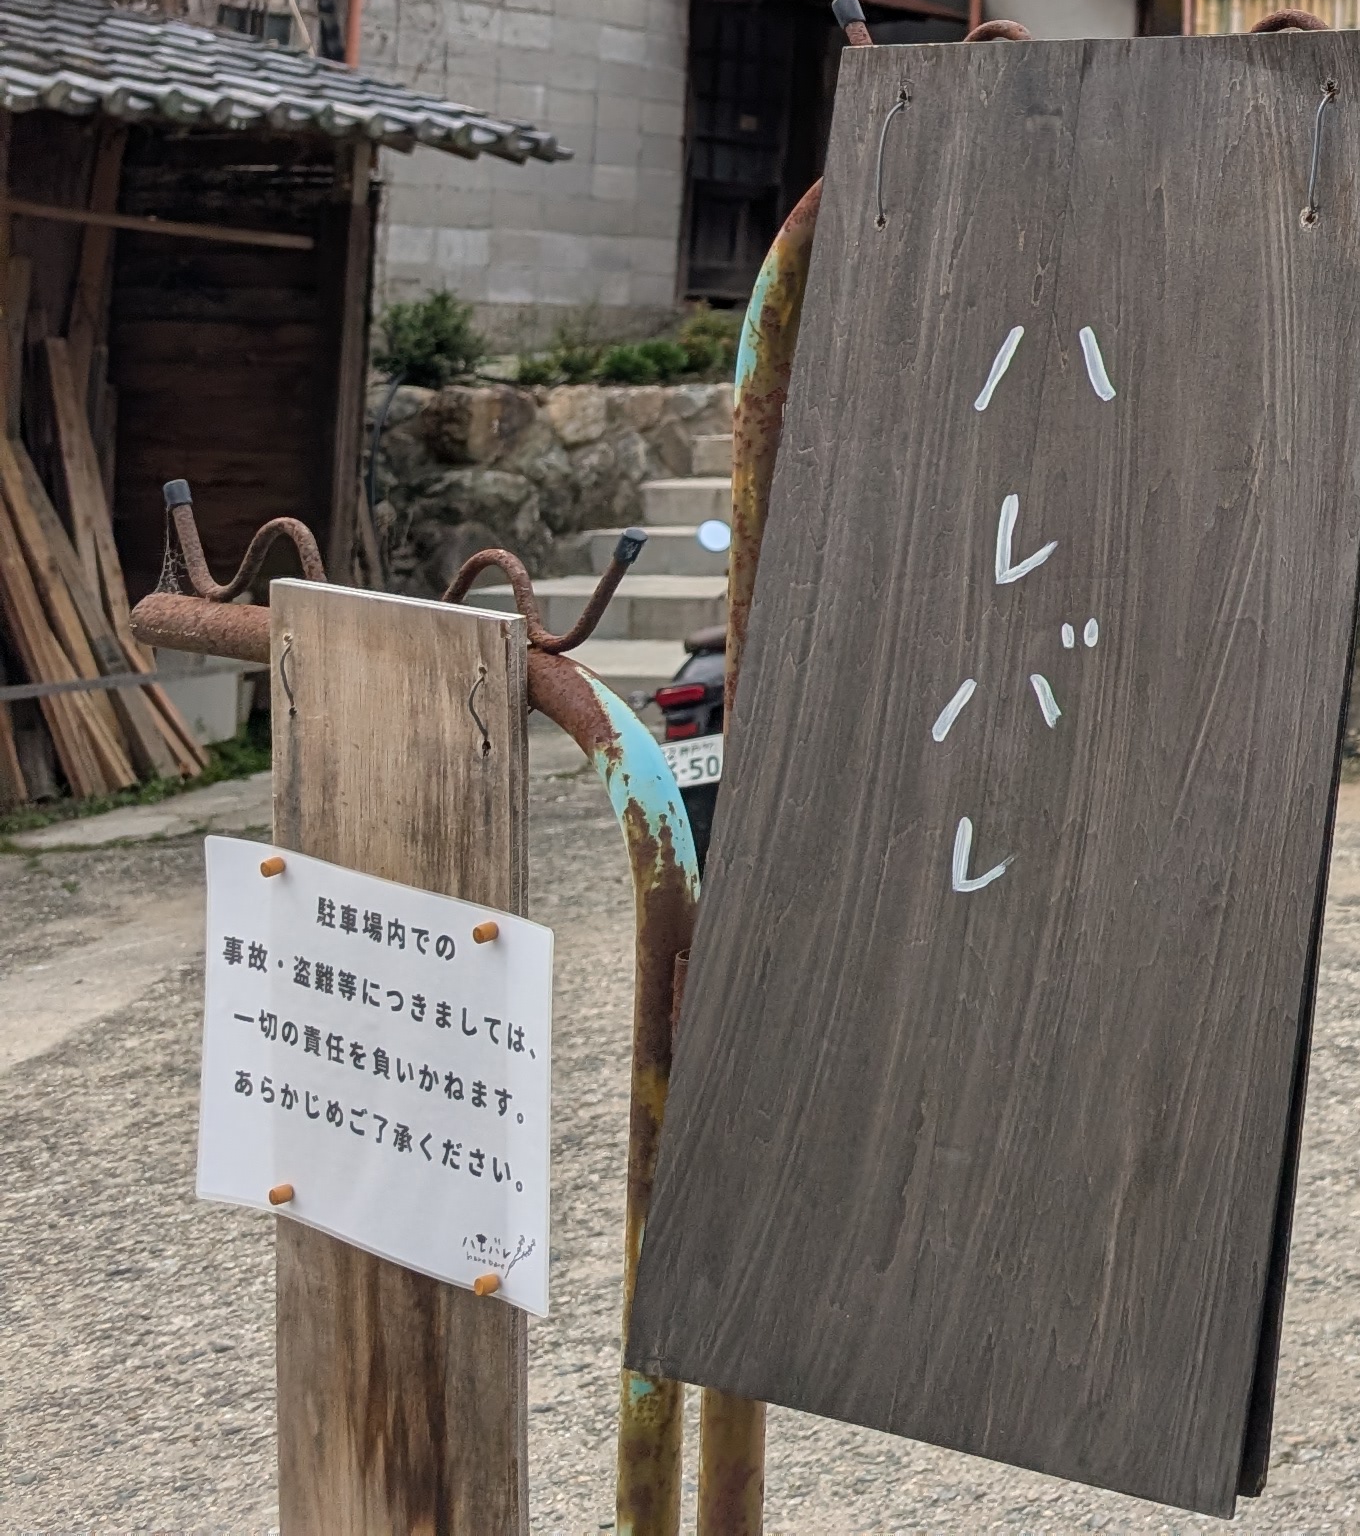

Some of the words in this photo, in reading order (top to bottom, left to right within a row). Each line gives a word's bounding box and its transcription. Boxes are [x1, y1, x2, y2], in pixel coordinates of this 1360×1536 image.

[932, 325, 1117, 892] ハレバレ
[316, 896, 456, 961] 駐車場内での
[222, 936, 536, 1060] 事故・盗難等につきましては、
[234, 1008, 524, 1124] 一切の責任を負いかねます。
[234, 1070, 523, 1193] あらかじめご了承ください。
